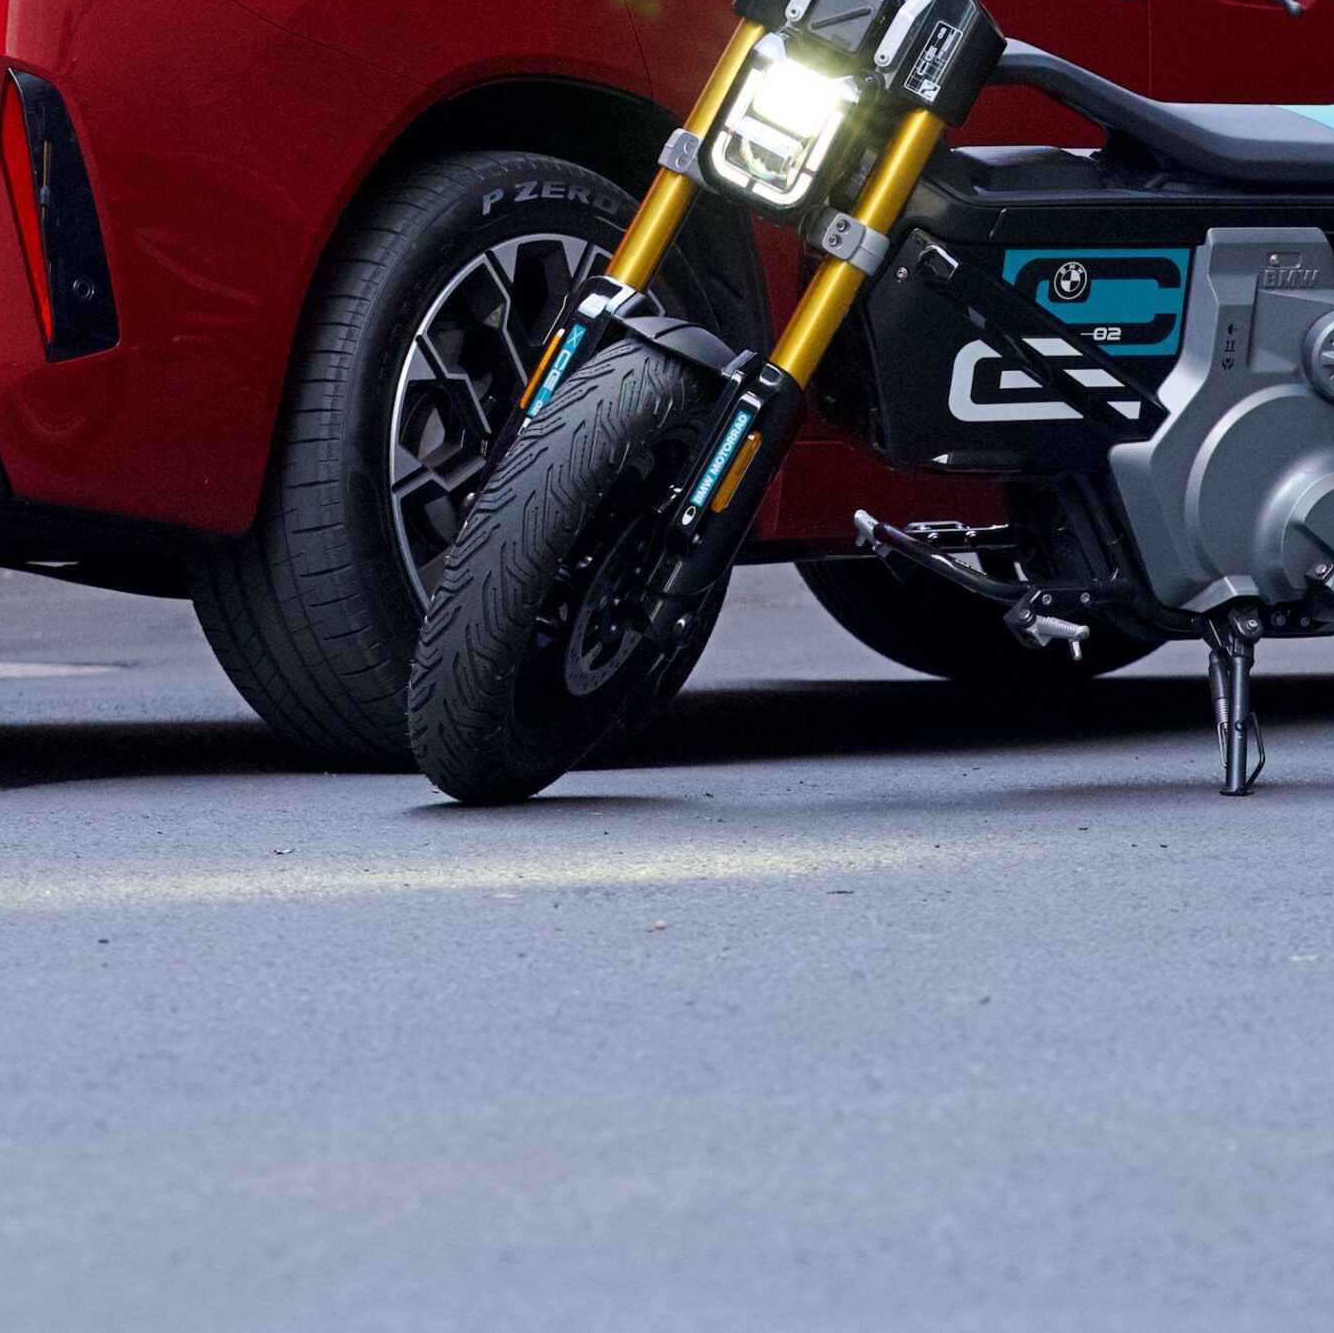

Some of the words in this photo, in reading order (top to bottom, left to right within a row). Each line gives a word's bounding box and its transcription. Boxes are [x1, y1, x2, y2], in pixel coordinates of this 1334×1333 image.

[482, 188, 505, 216] P
[514, 179, 622, 215] ZERO
[1264, 269, 1321, 289] BMW
[692, 475, 715, 504] BMW
[707, 413, 749, 475] MOTORRAD
